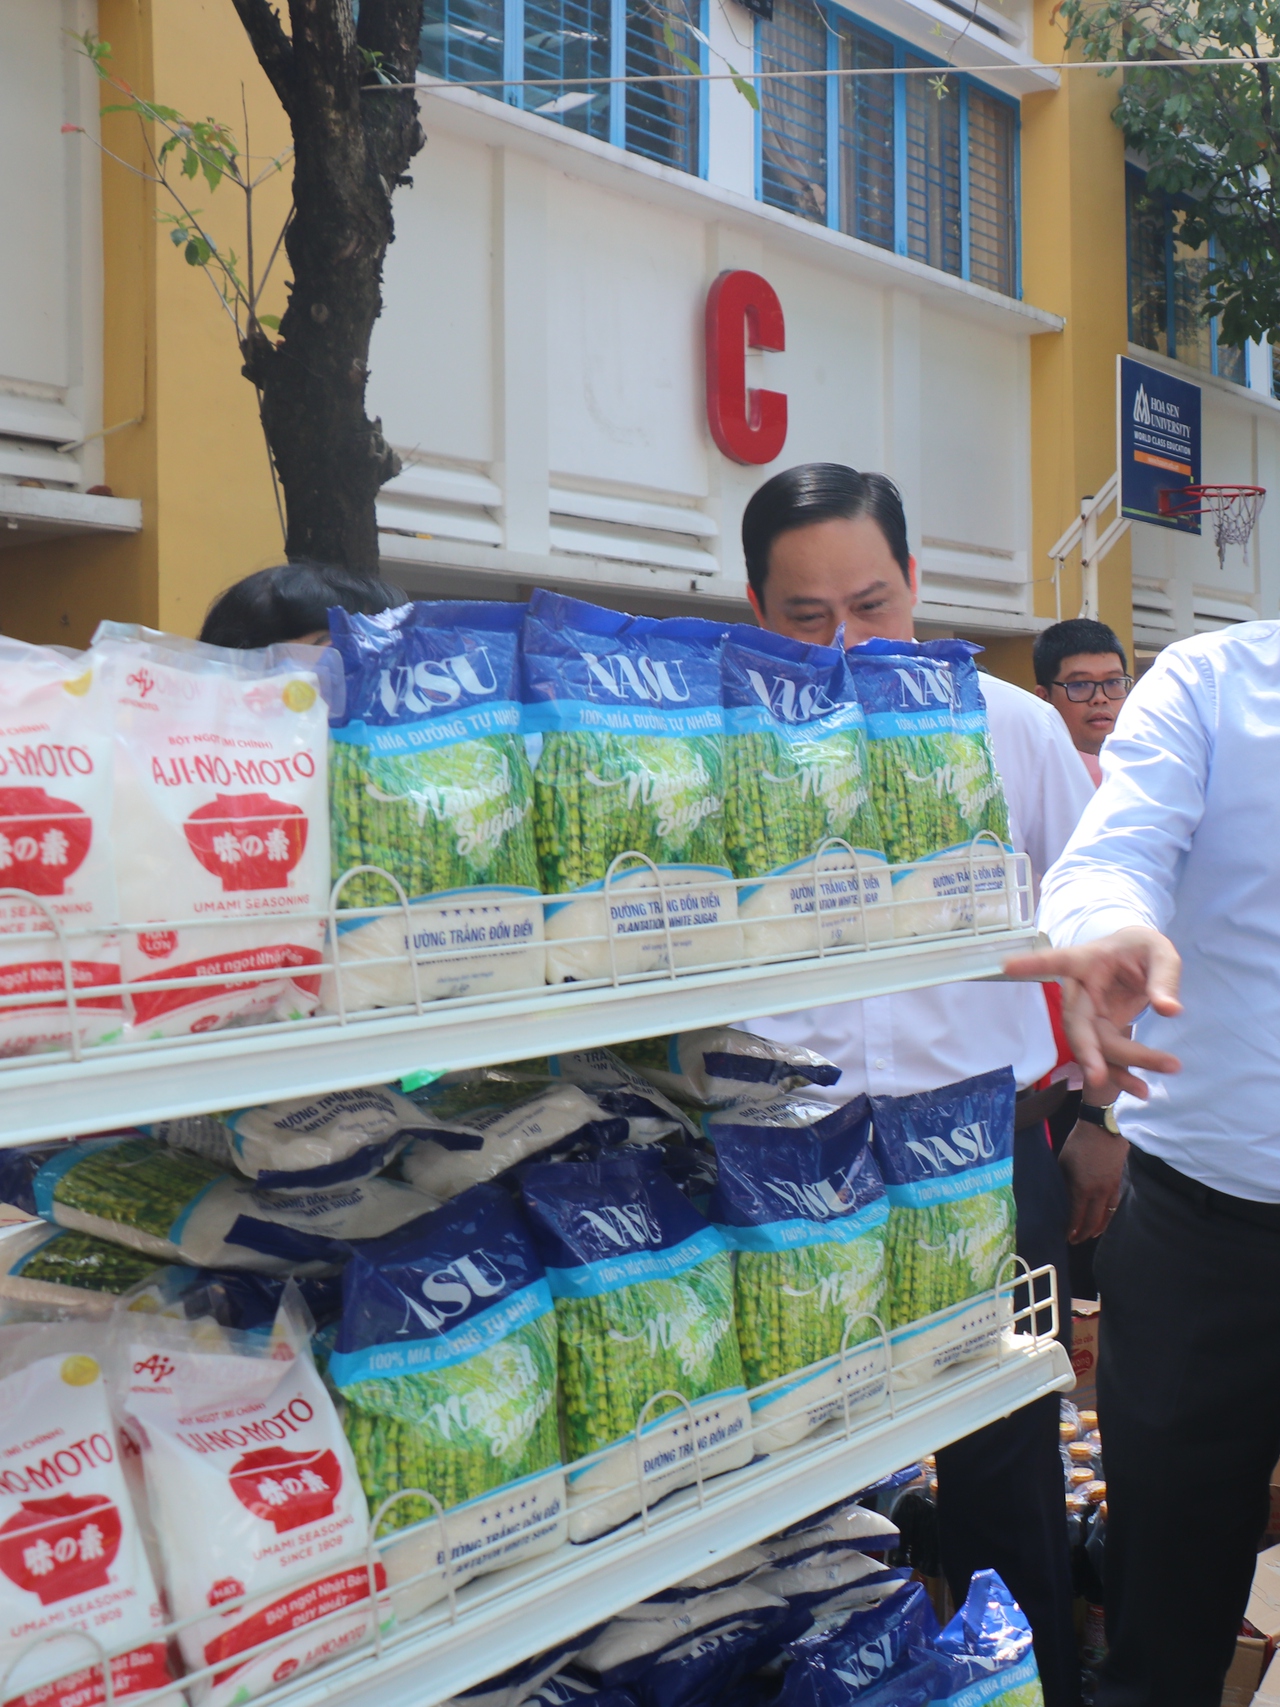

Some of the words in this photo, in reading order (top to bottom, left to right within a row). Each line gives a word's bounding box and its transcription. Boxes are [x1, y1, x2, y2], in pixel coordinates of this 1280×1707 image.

[706, 269, 787, 465] C
[1151, 397, 1165, 413] HOA
[1166, 403, 1179, 418] SEN
[1151, 413, 1191, 438] UNIVERSITY
[1134, 431, 1151, 443] WORLD
[1152, 435, 1166, 448] CLASS
[1166, 441, 1191, 455] EDUCATION
[580, 652, 690, 702] NASU
[376, 732, 409, 751] MÍA
[408, 720, 468, 746] ĐƯỜNG
[468, 714, 492, 732] TỰ
[607, 711, 632, 728] MÍA
[633, 711, 669, 731] ĐƯỜNG
[668, 717, 684, 734] TỰ
[686, 713, 723, 728] NHIÊN
[918, 715, 938, 730] MÍA
[656, 790, 726, 837] Sugar
[456, 797, 534, 856] Sugar
[213, 828, 290, 864] 味の素
[789, 883, 815, 900] ĐƯỜN
[933, 873, 955, 888] ĐƯỜNG
[194, 902, 241, 913] UMAMI
[246, 894, 310, 909] SEASONING
[610, 901, 647, 920] ĐƯỜNG
[668, 914, 692, 928] WHITE
[693, 912, 718, 924] SUGAR
[529, 1123, 542, 1135] kg
[905, 1120, 995, 1174] NASU
[762, 1166, 857, 1218] NASU
[918, 1186, 942, 1200] 100%
[580, 1203, 662, 1251] NASU
[667, 1244, 701, 1270] NHIÊN
[368, 1354, 405, 1370] 100%
[407, 1345, 432, 1365] MÍA
[22, 1522, 105, 1577] 味の素
[253, 1540, 296, 1561] UMAMI
[297, 1514, 354, 1544] SEASONING
[279, 1545, 313, 1567] SINCE
[265, 1606, 289, 1626] Bột
[289, 1592, 317, 1614] ngọt
[317, 1578, 346, 1598] Nhật
[10, 1611, 66, 1638] UMAMI
[292, 1609, 317, 1627] DUY
[979, 1680, 1000, 1698] MÍA
